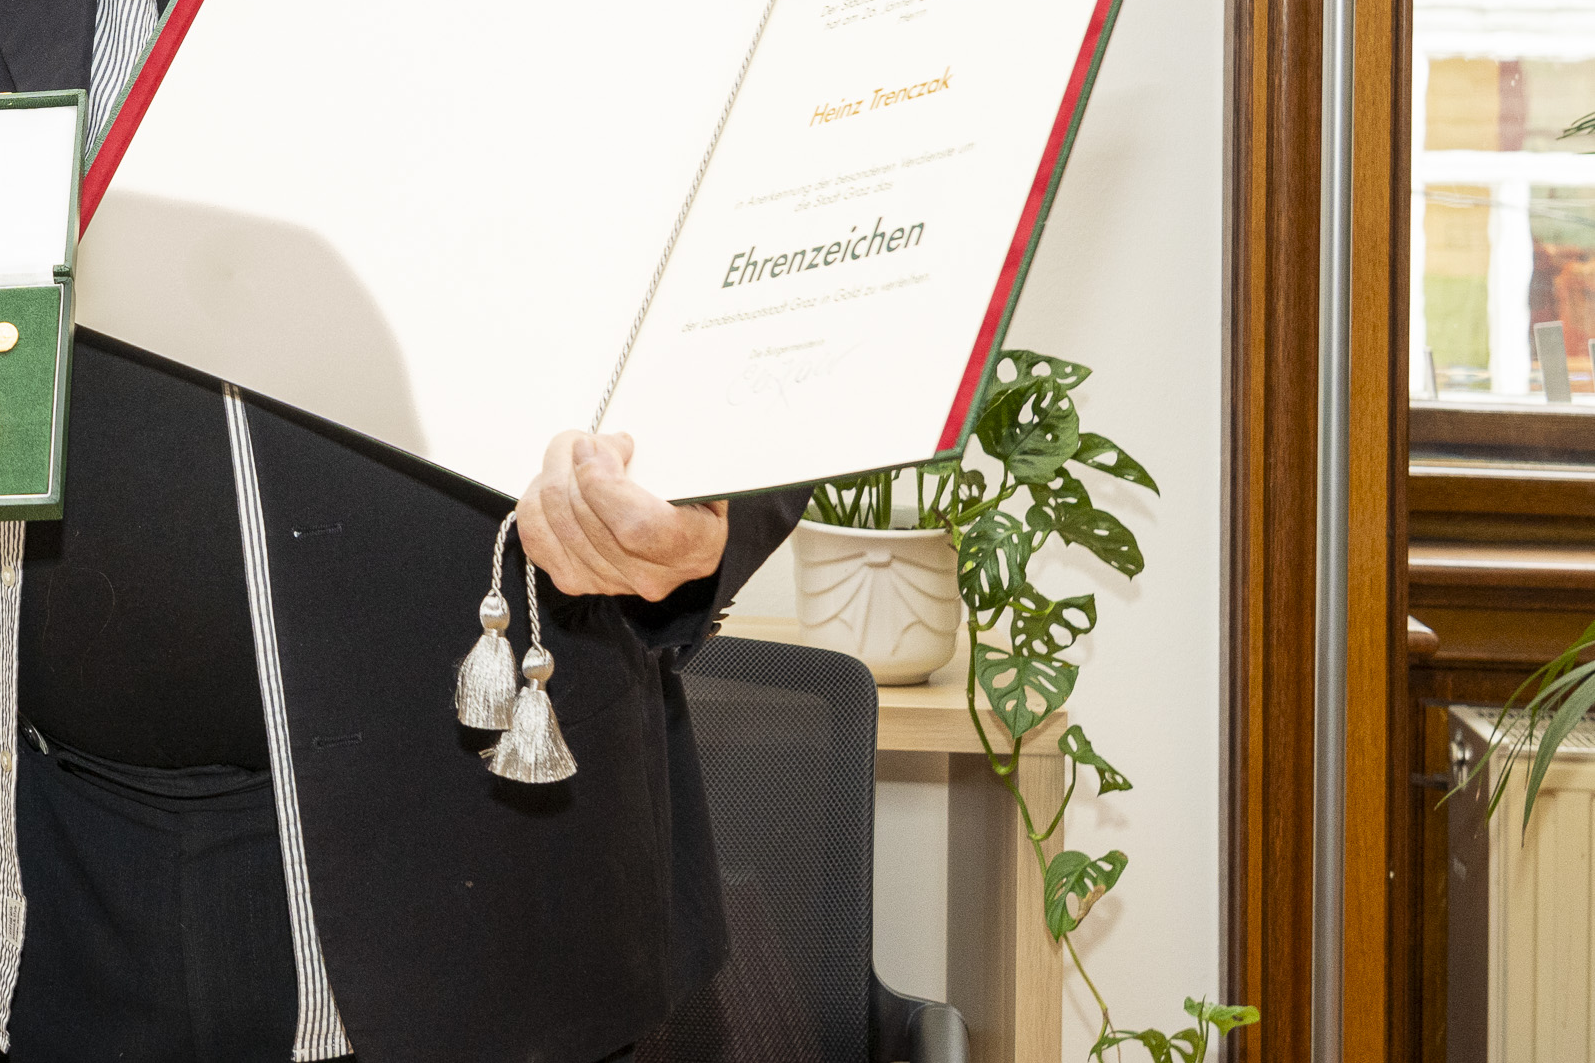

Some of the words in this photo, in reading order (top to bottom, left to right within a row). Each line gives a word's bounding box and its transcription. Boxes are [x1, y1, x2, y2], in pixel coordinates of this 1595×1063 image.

[809, 98, 864, 127] Heinz
[870, 66, 954, 111] Trenczak
[721, 216, 925, 289] Ehrenzeichen
